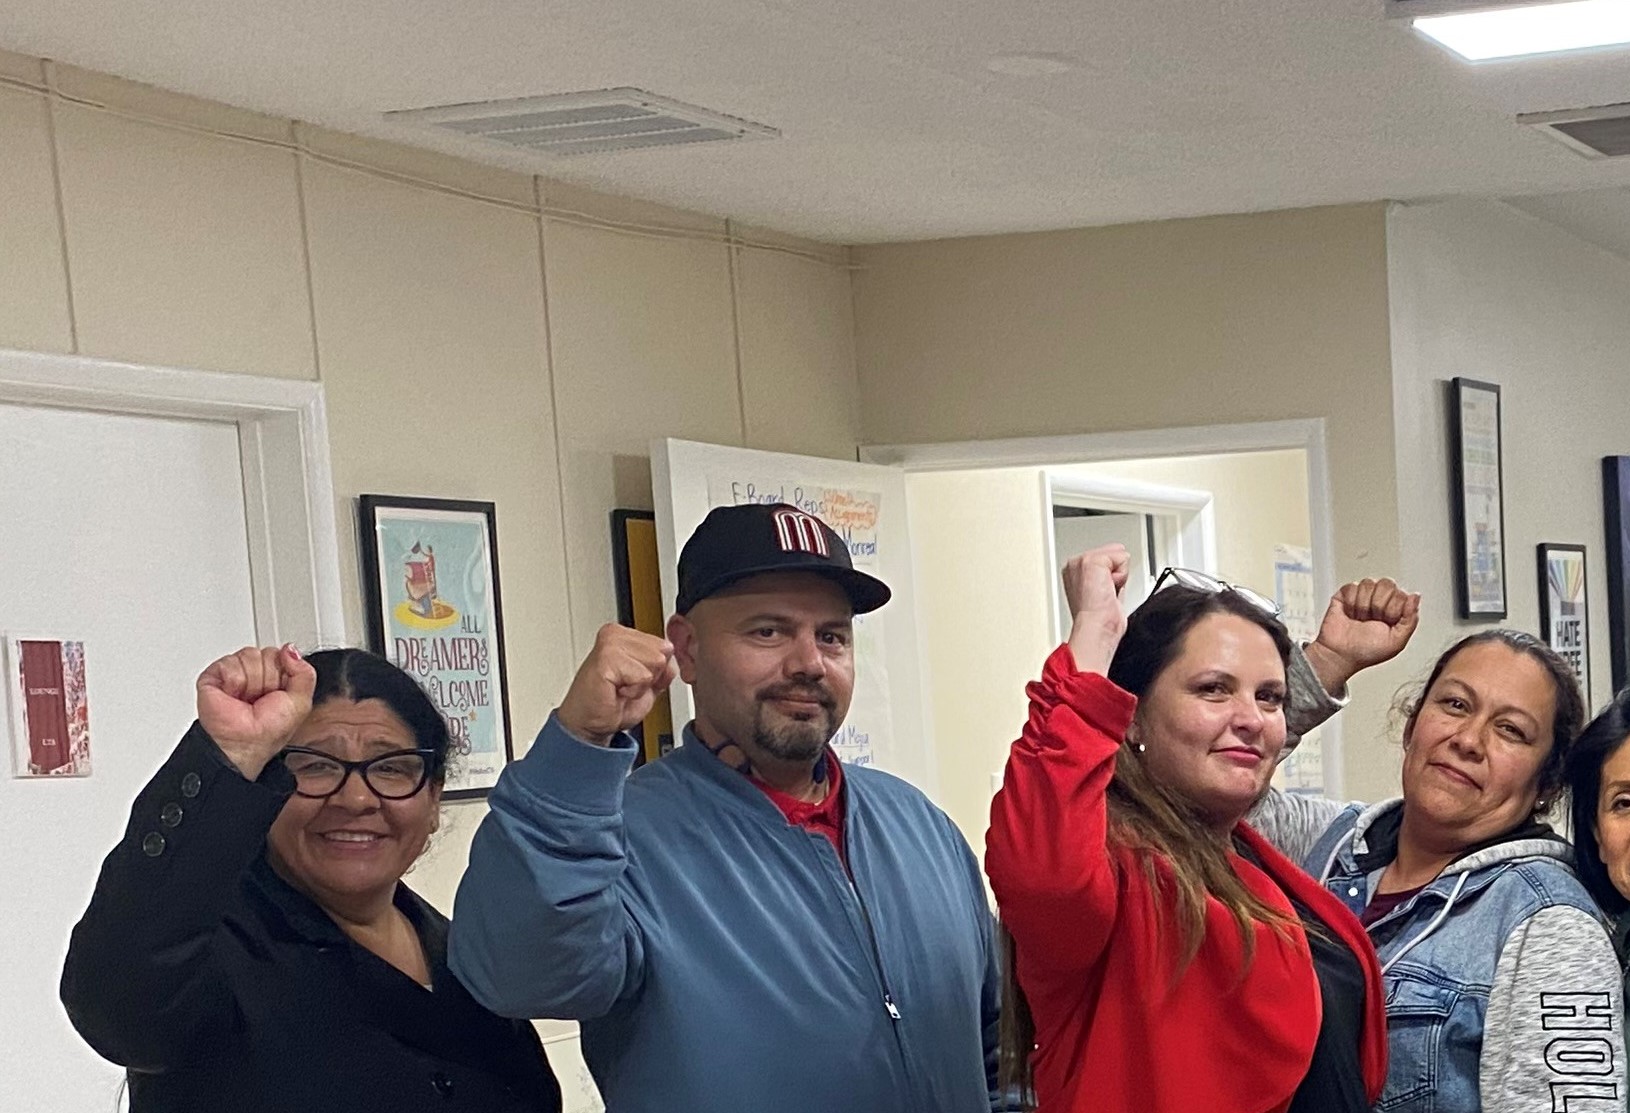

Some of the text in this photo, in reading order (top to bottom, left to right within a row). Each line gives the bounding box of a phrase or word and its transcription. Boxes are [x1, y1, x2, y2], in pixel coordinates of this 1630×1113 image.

[460, 615, 482, 634] ALL
[1556, 620, 1581, 648] HATE
[395, 637, 490, 676] DREAMERS
